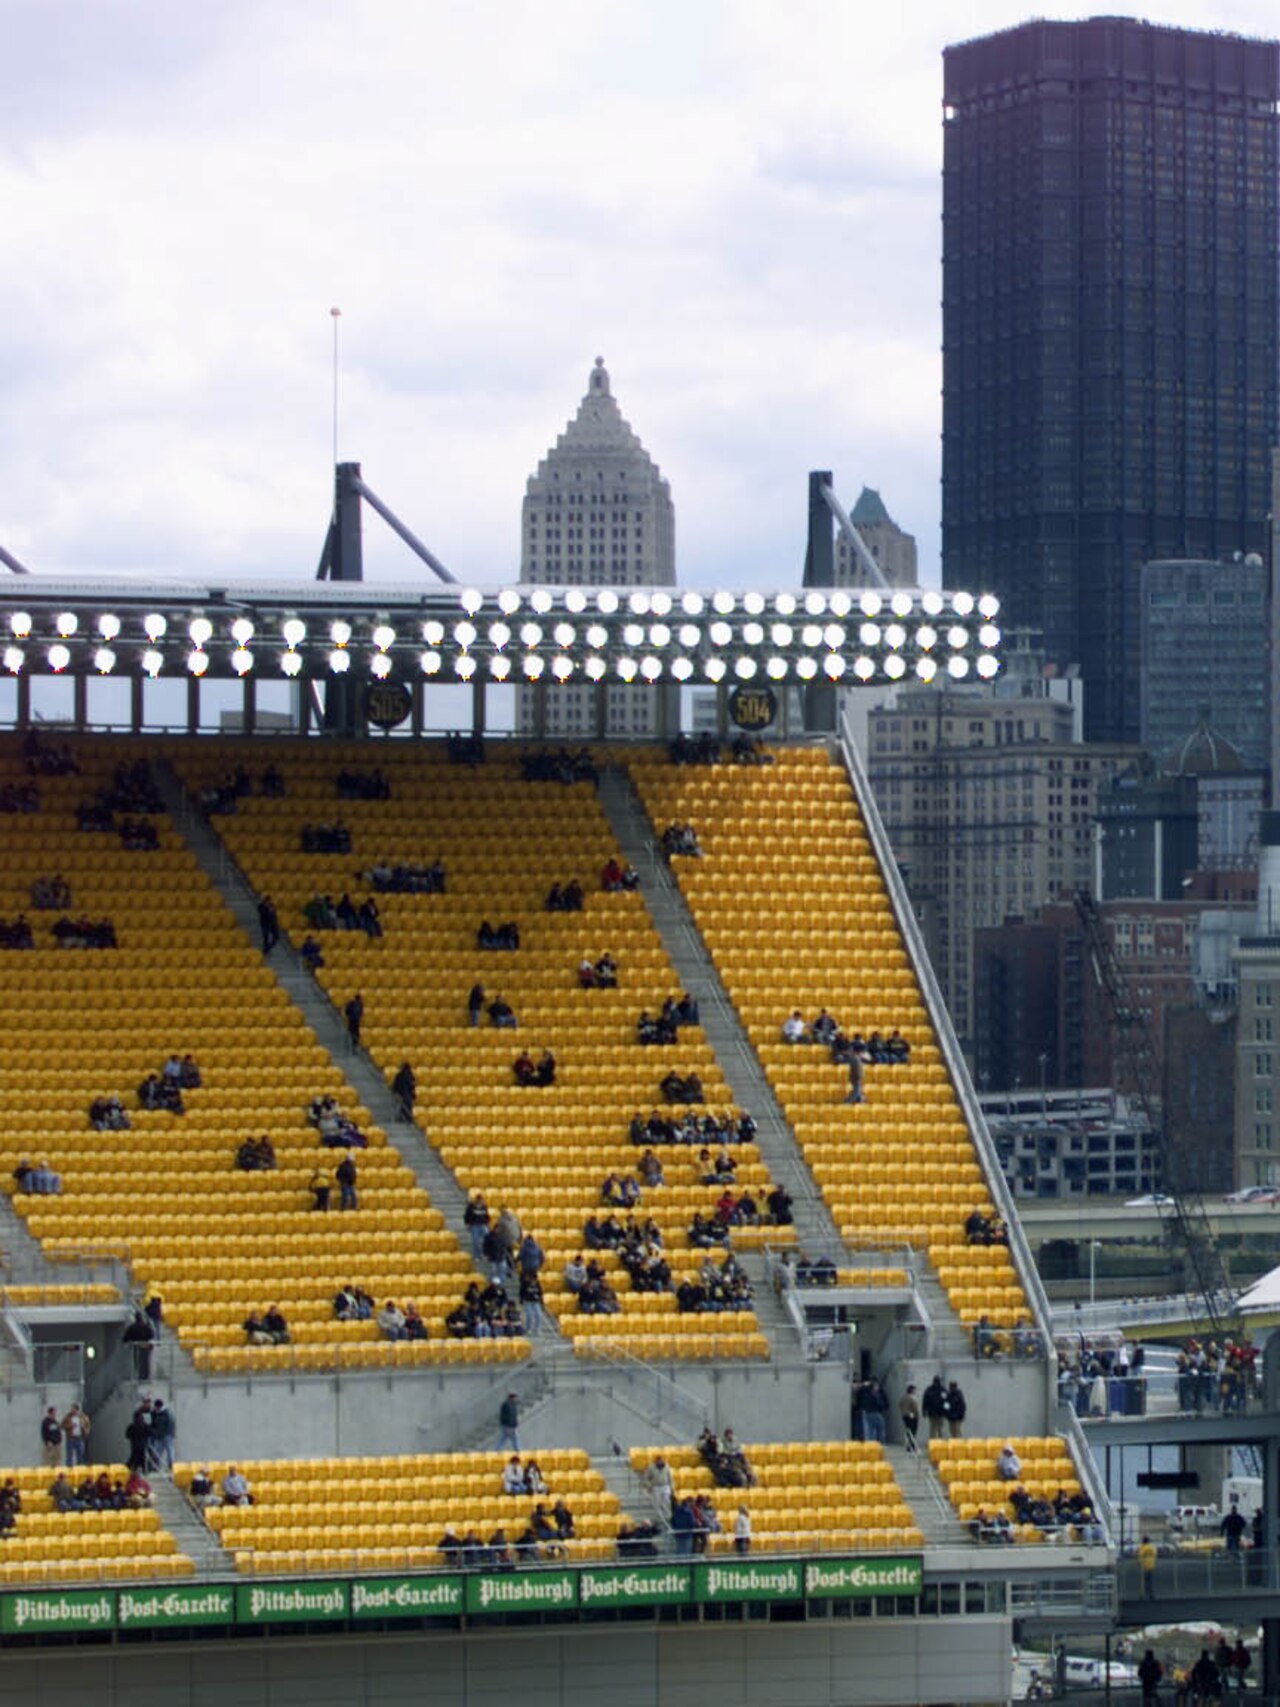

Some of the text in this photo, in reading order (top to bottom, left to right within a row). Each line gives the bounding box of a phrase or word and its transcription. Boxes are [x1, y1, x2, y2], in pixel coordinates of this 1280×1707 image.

[736, 696, 770, 723] 504
[479, 1571, 689, 1606] Pittsburgh Post-Gazette
[707, 1563, 921, 1594] Pittsburgh Post-Gazette
[15, 1592, 231, 1626] Pittsburgh Post-Gazette
[251, 1582, 462, 1616] Pittsburgh Post-Gazette
